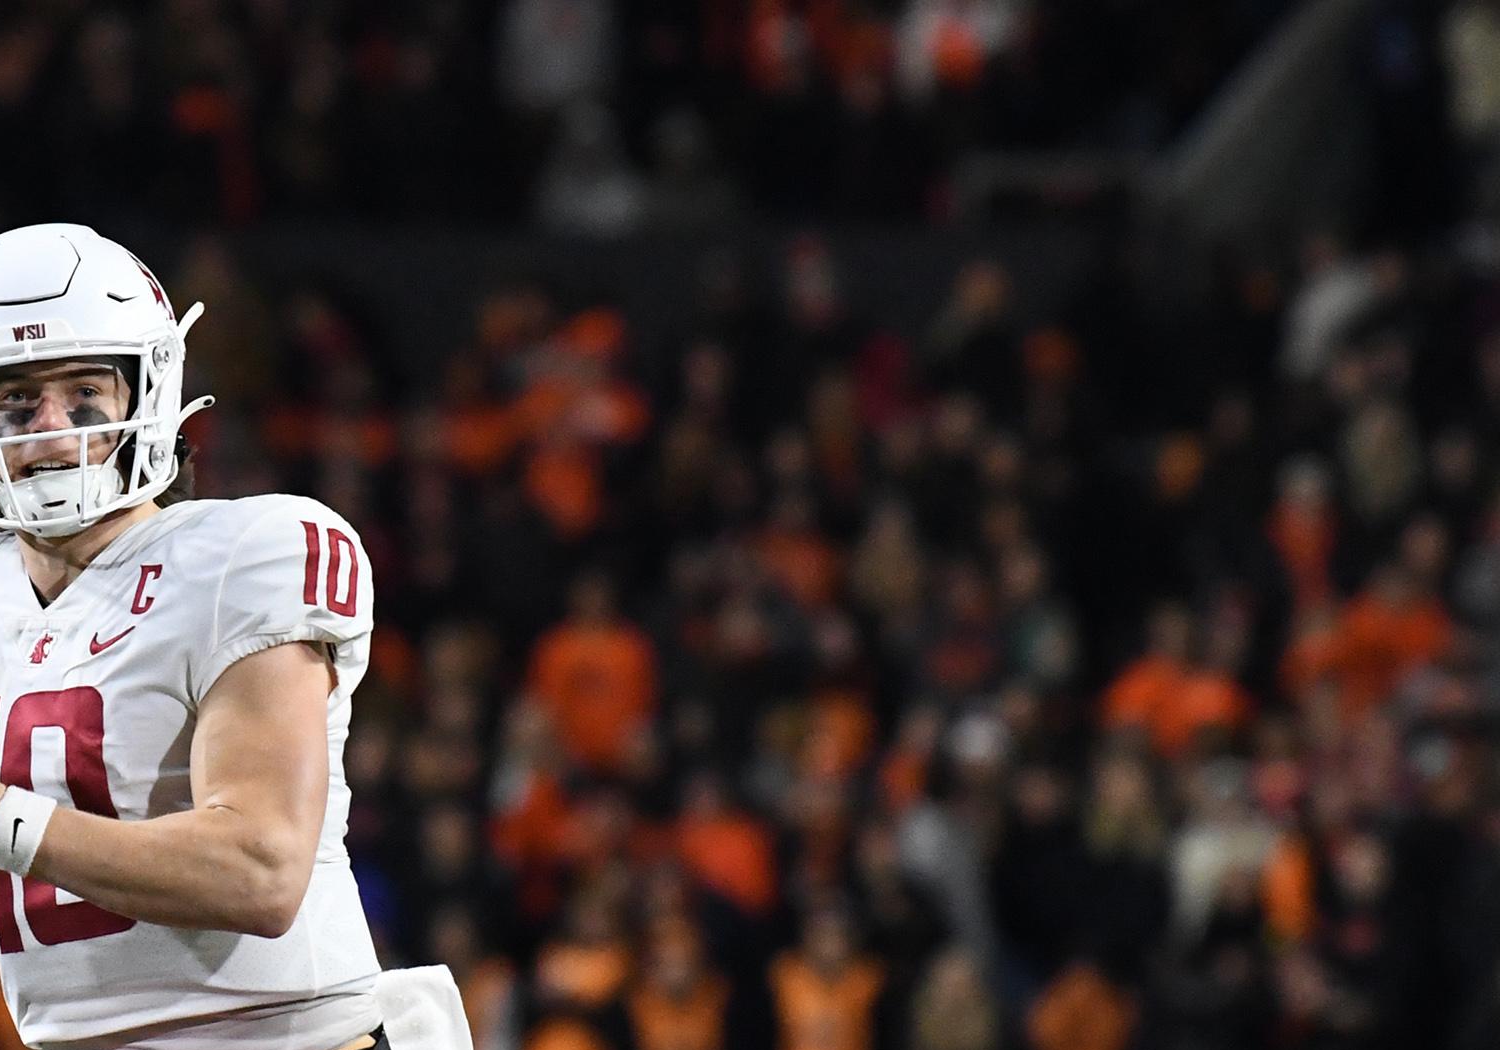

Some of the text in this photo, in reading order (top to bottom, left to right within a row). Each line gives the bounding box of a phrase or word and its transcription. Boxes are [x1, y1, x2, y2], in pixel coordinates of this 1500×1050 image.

[11, 323, 46, 342] WSU
[130, 563, 163, 615] C
[299, 520, 359, 617] 10
